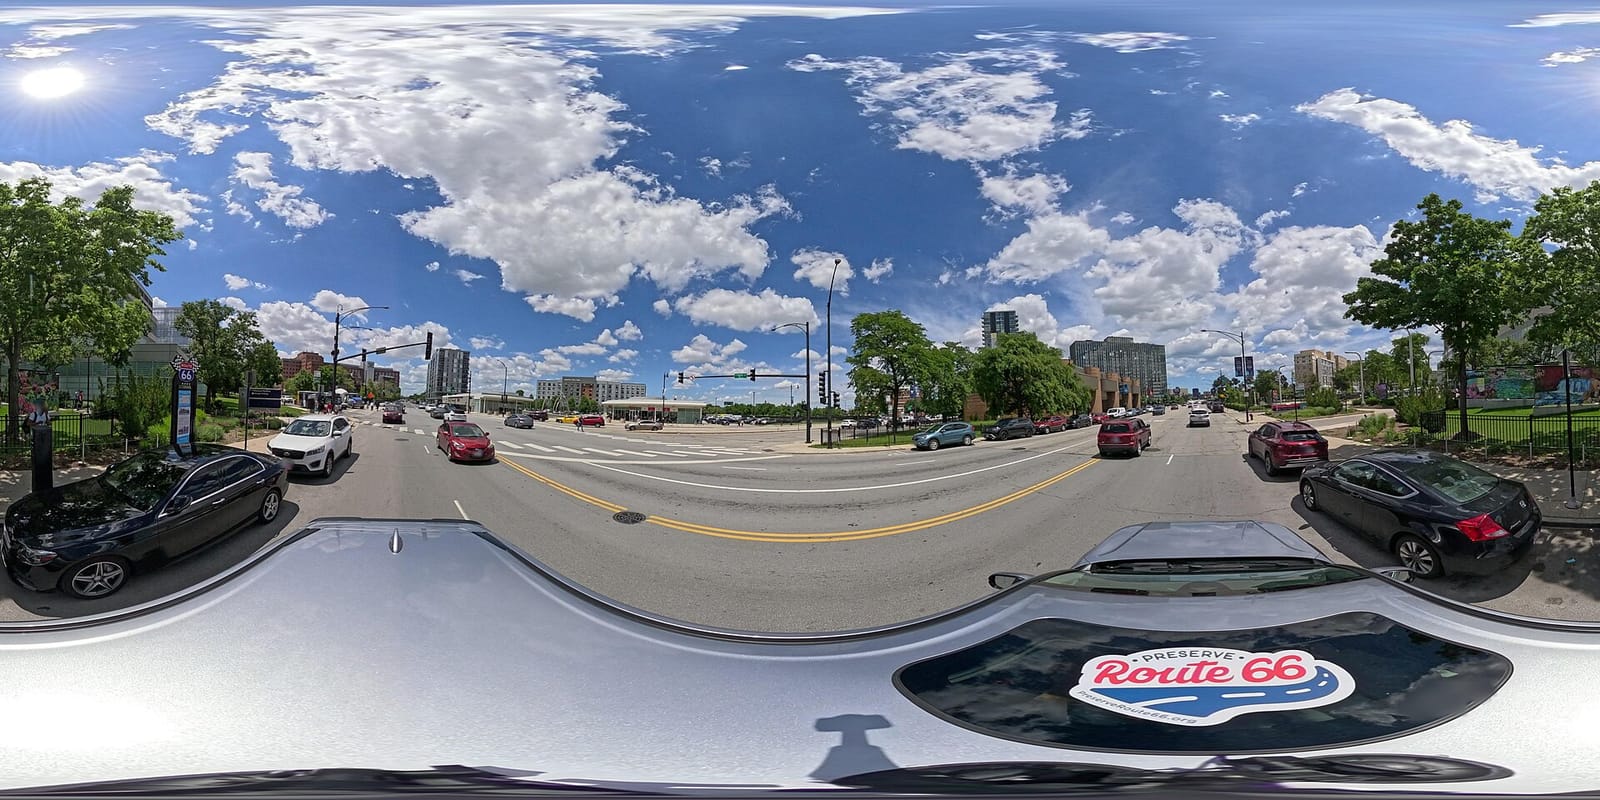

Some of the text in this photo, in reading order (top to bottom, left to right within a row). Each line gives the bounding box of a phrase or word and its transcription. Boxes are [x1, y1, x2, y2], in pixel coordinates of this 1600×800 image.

[181, 370, 192, 380] 66
[1142, 650, 1235, 662] PRESERVE
[1093, 655, 1307, 684] Route 66
[1077, 690, 1197, 724] PreserveRoute66.org
